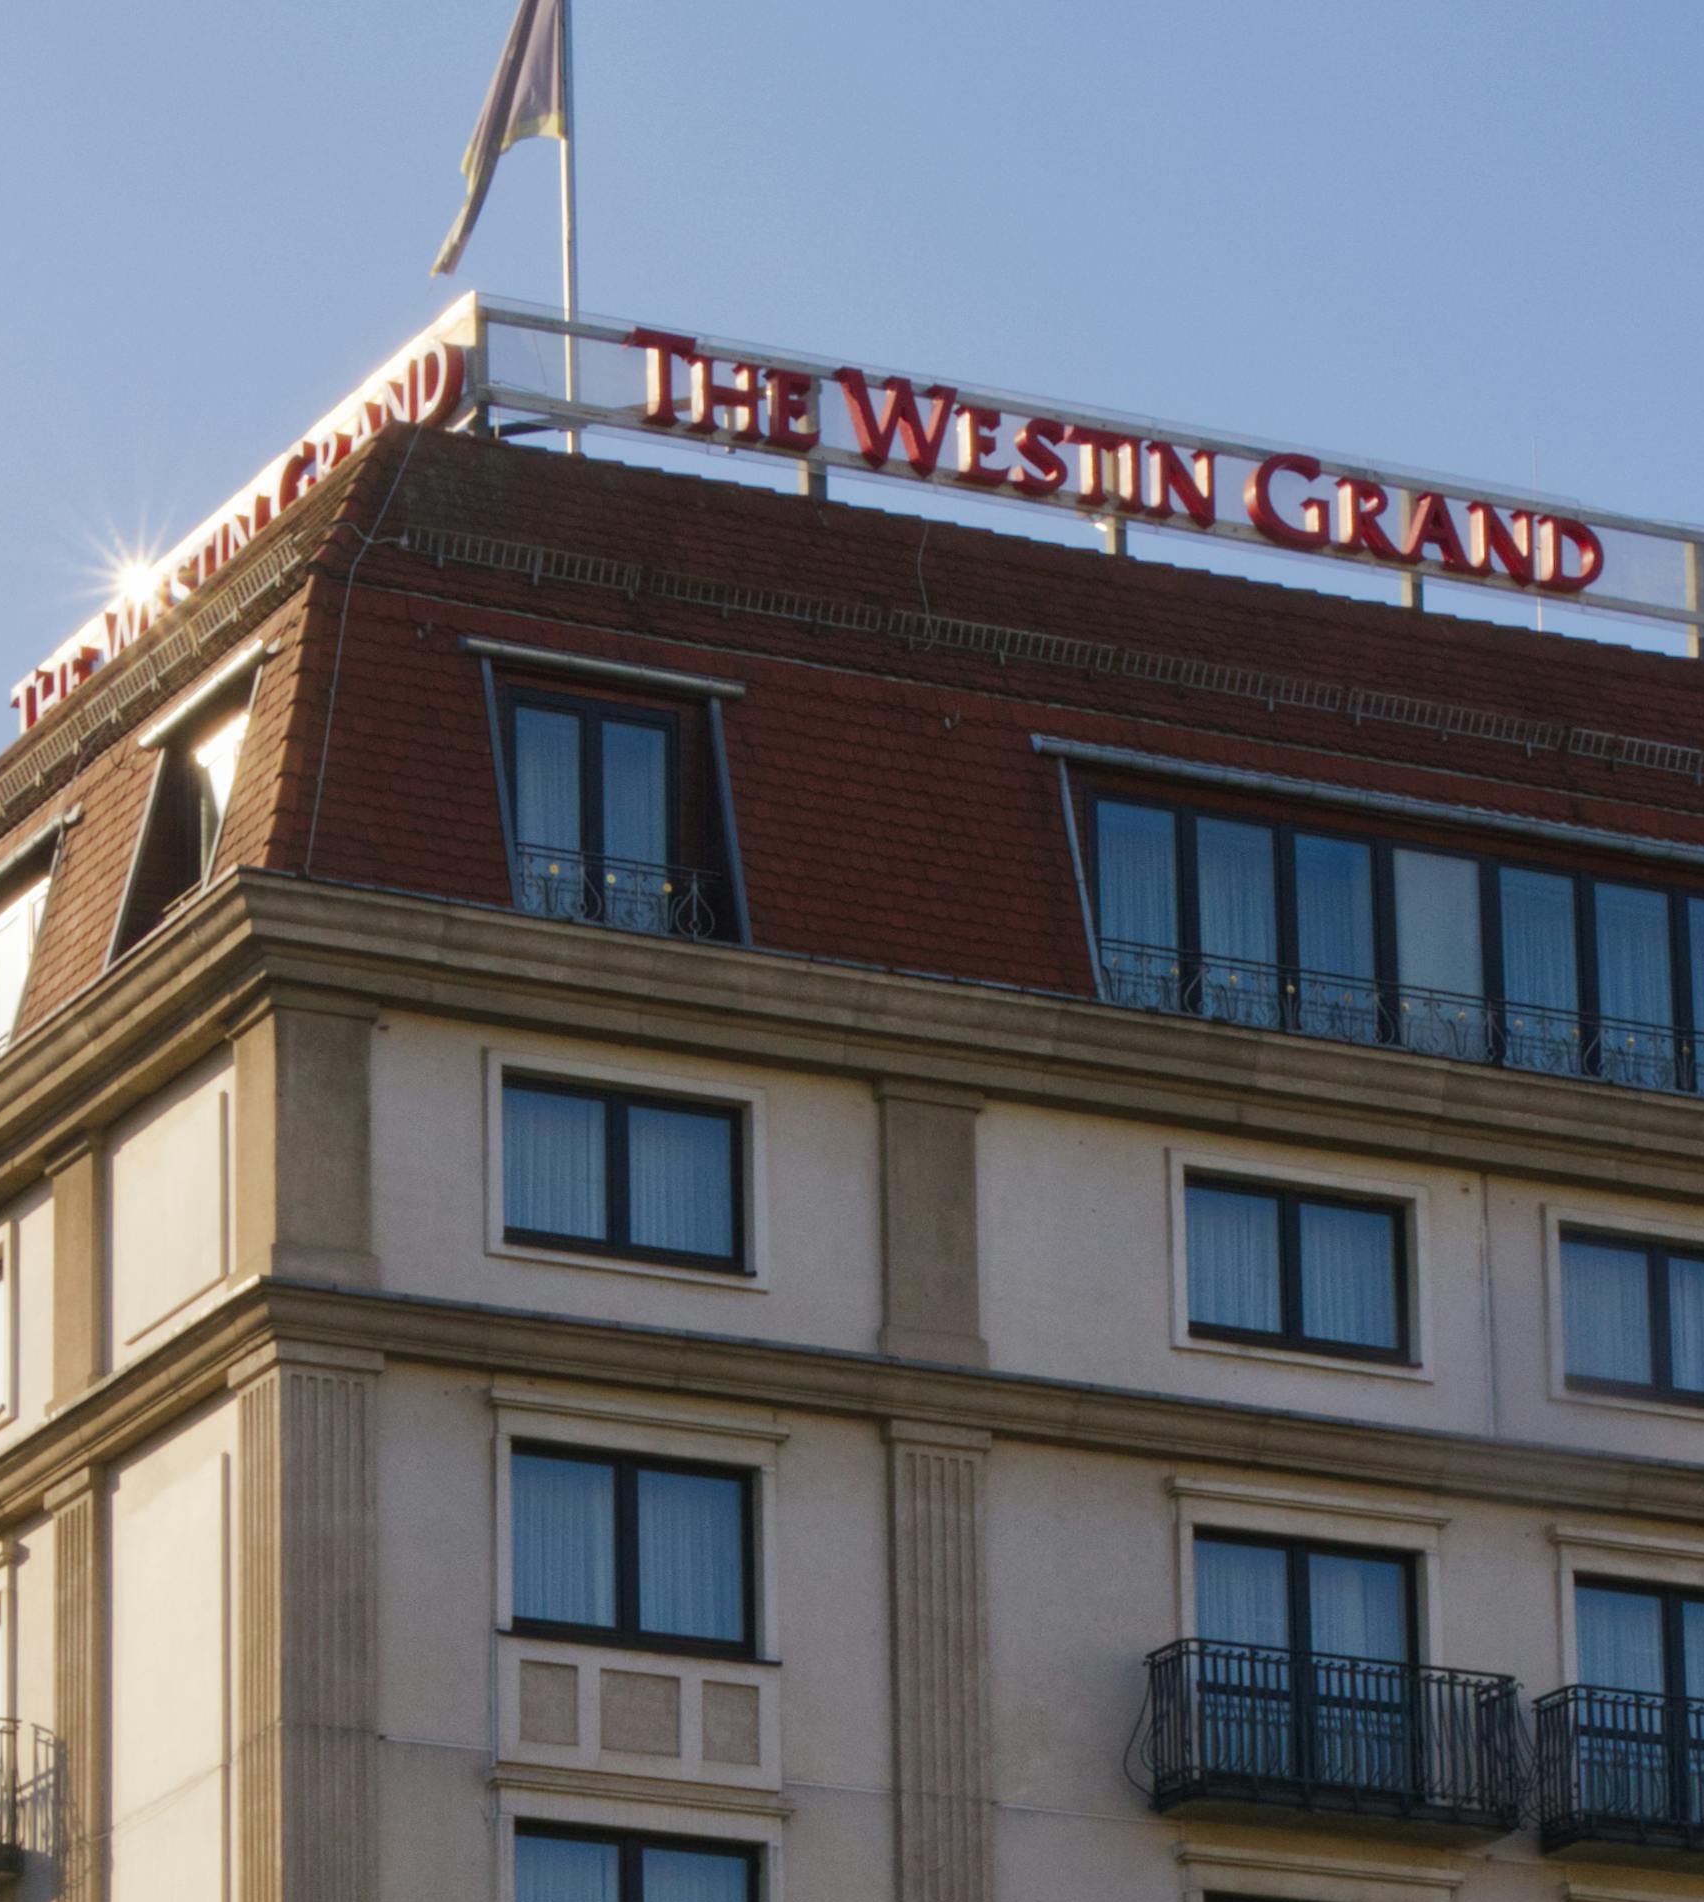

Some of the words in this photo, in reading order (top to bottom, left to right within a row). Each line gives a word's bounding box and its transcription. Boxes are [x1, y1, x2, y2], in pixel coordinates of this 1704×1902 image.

[100, 494, 270, 664] WSTIN
[270, 339, 466, 519] GRAND
[623, 326, 821, 452] THE
[832, 366, 1218, 529] WESTIN
[1243, 452, 1605, 594] GRAND
